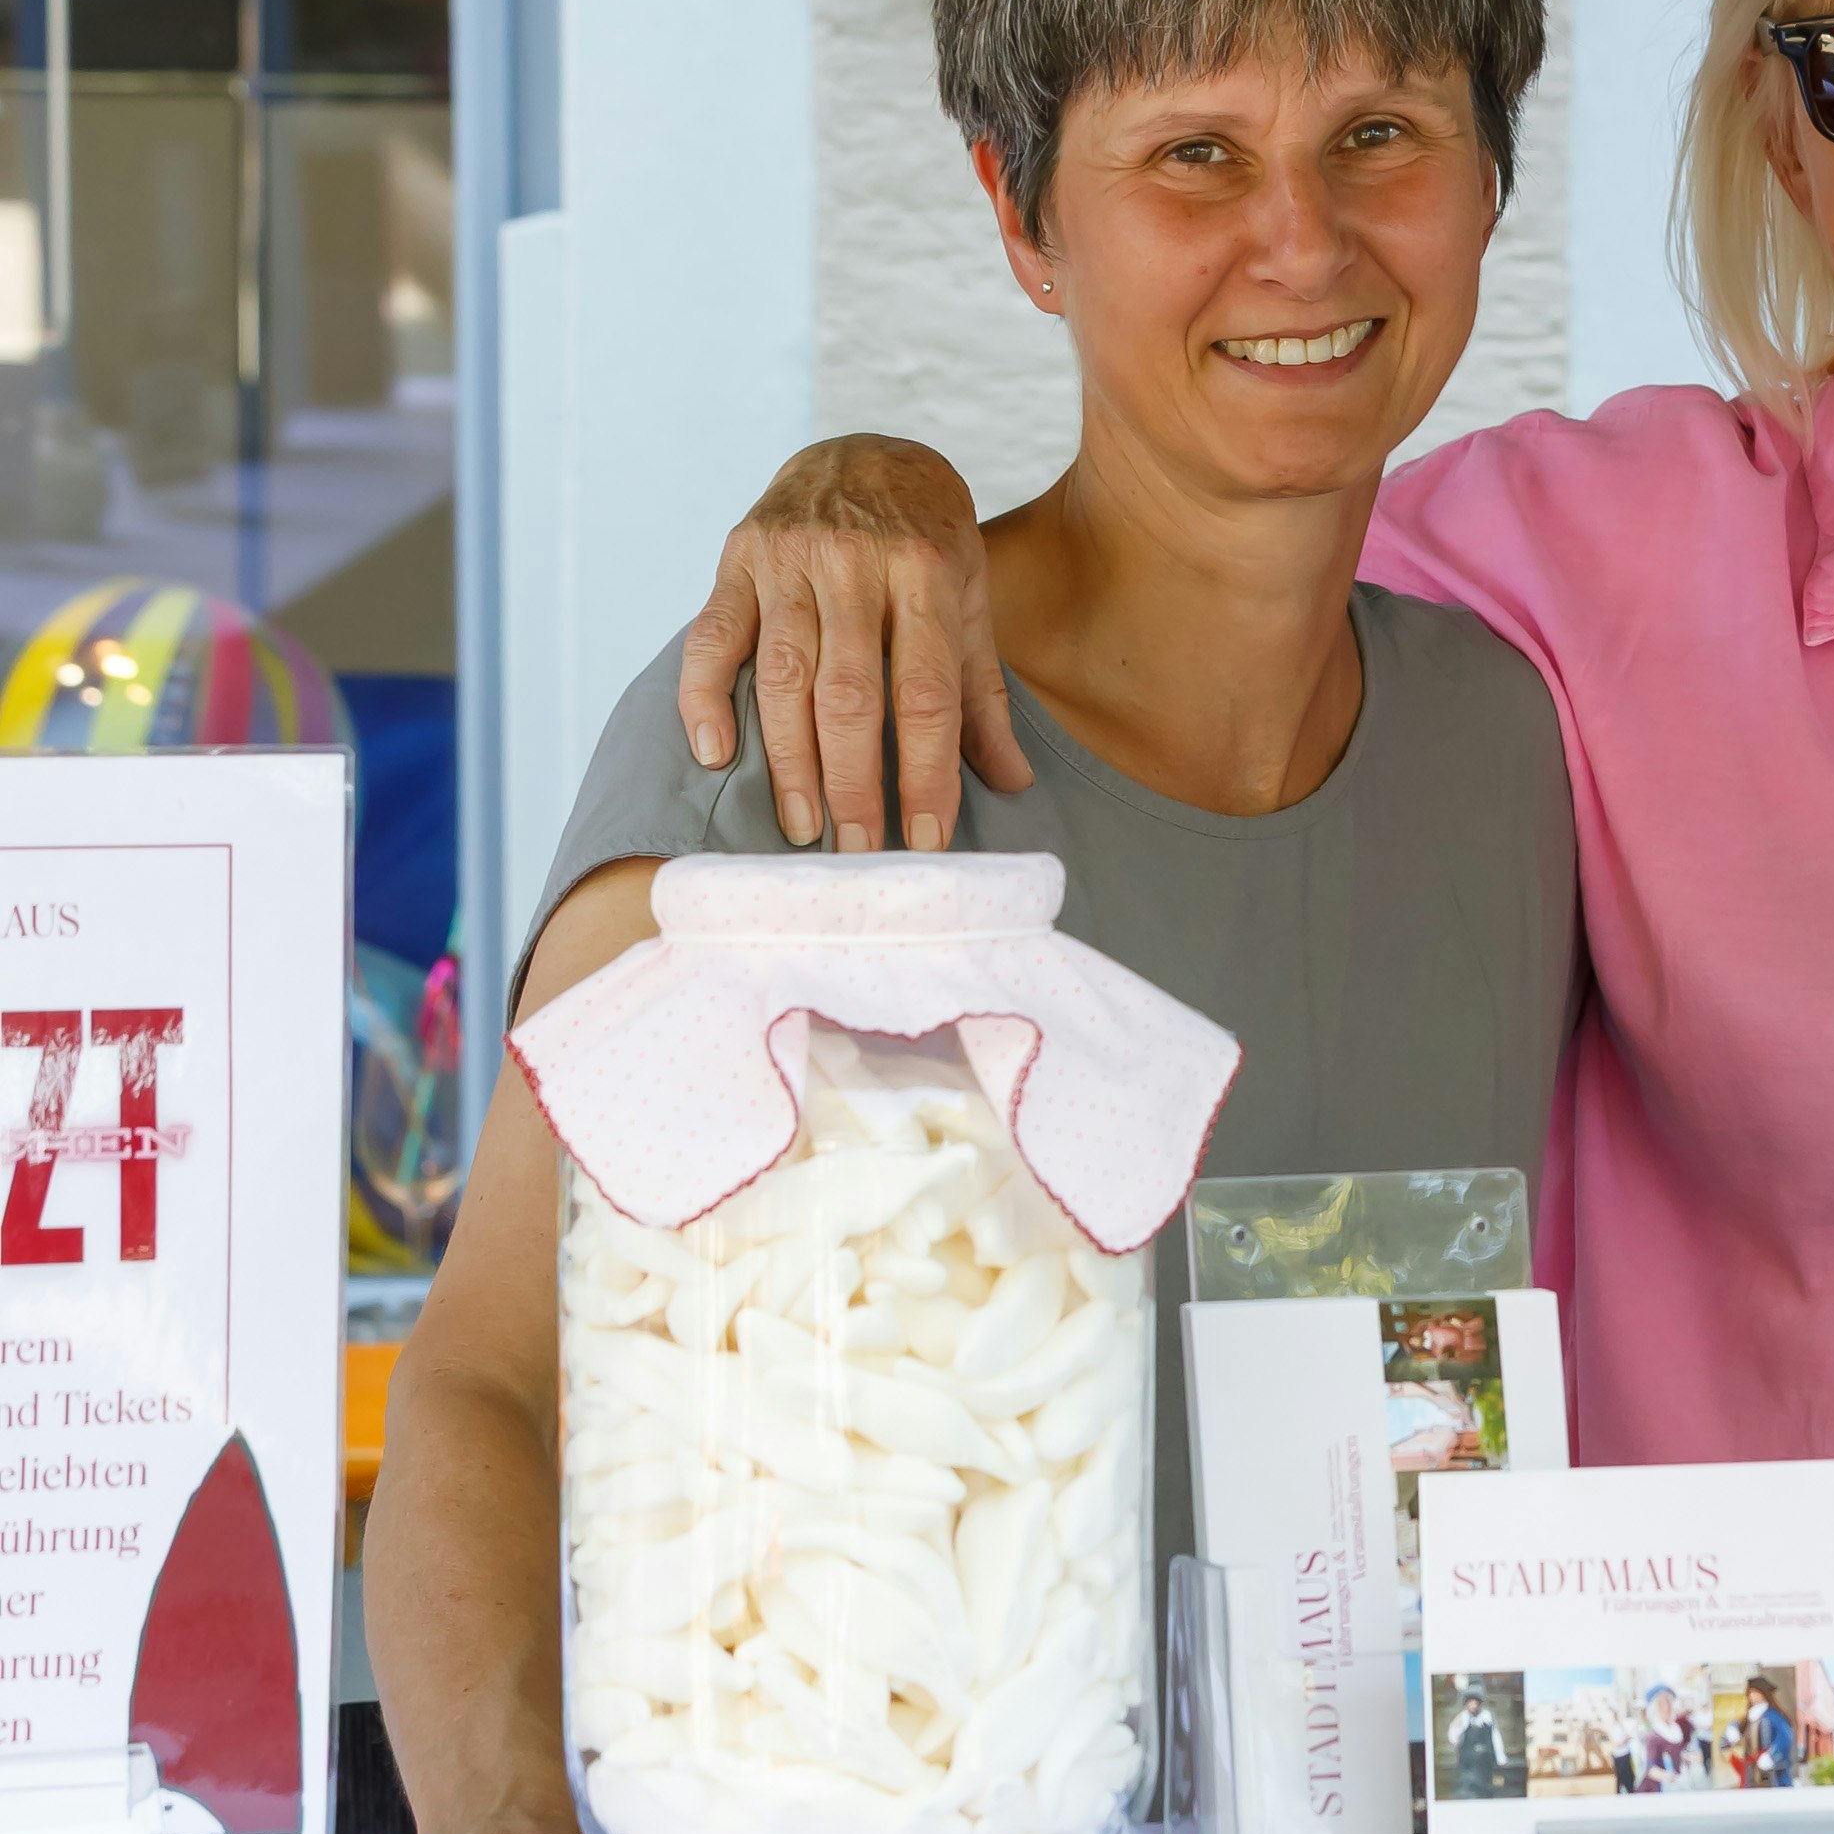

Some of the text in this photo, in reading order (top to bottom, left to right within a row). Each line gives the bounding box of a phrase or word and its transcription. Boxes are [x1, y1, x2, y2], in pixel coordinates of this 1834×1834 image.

[0, 1337, 74, 1365] rem
[54, 1388, 193, 1427] Tickets
[0, 1453, 148, 1492] eliebten
[0, 1518, 142, 1558] ührung
[1452, 1553, 1721, 1600] STADTMAUS
[0, 1591, 45, 1618] er
[1294, 1549, 1344, 1817] STADTMAUS
